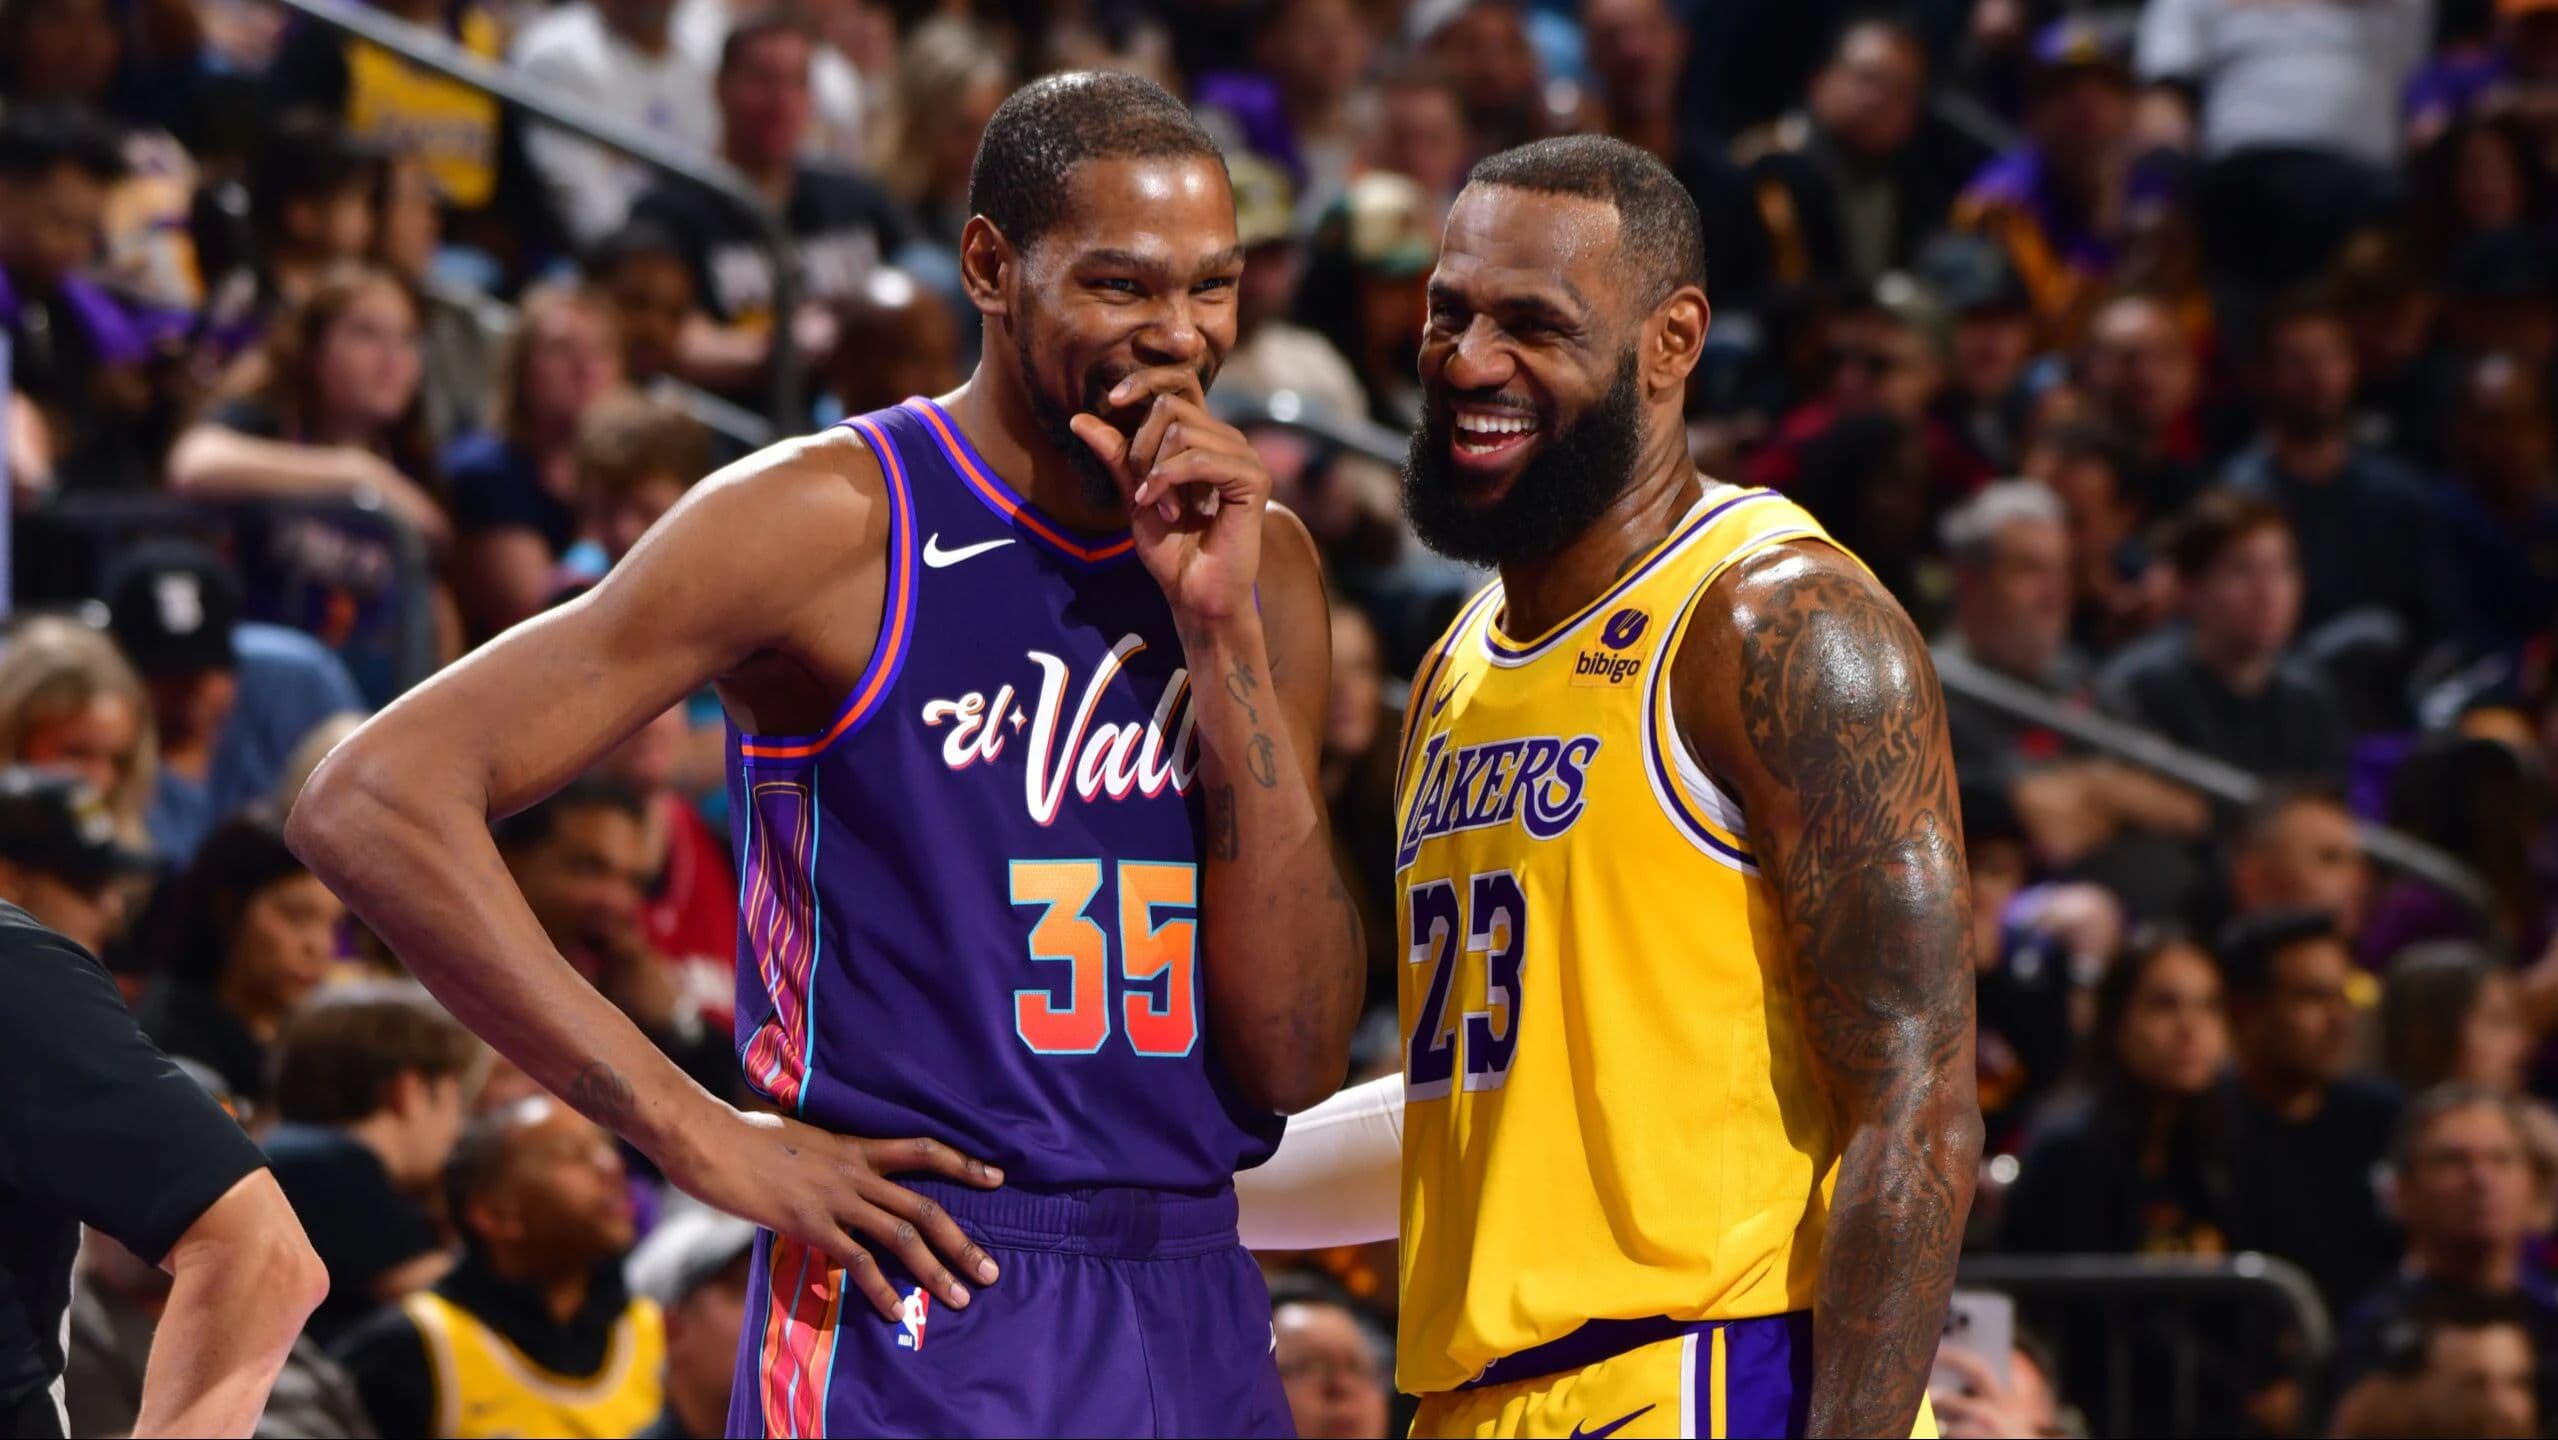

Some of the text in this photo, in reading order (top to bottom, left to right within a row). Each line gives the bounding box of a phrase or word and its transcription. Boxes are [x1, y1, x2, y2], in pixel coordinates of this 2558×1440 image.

[1575, 651, 1641, 684] bibigo
[922, 684, 1015, 769] El
[1396, 728, 1604, 875] LAKERS
[1008, 858, 1198, 1057] 35
[1406, 868, 1528, 1103] 23
[898, 1333, 913, 1347] NBA
